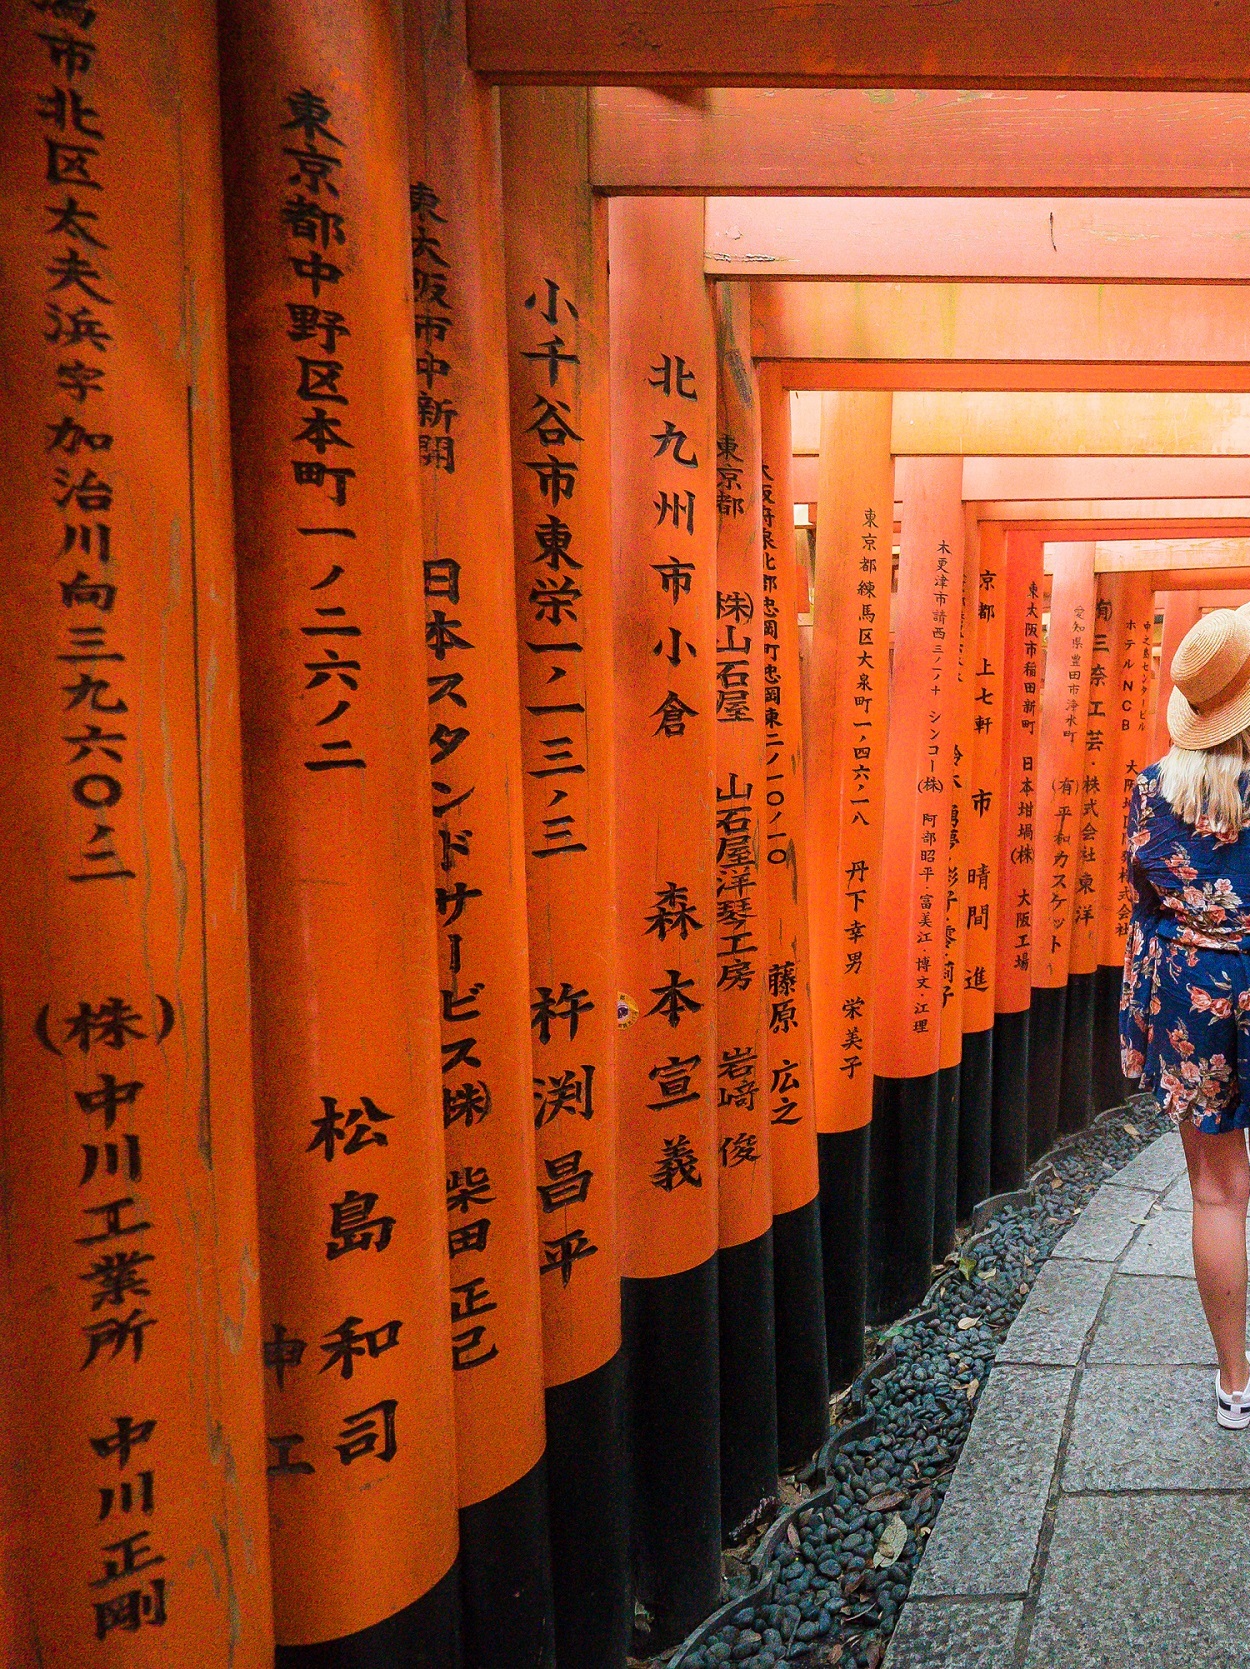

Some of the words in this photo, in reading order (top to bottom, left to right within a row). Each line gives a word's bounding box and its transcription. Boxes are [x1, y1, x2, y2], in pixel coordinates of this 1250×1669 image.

[716, 434, 745, 519] 東京都
[647, 353, 700, 738] 北九州市小倉
[977, 568, 997, 624] 京都
[716, 591, 754, 722] 株)山石屋
[974, 658, 996, 735] 上七軒
[1021, 580, 1039, 735] 東大阪市稲田新町
[716, 773, 758, 991] 山石屋洋琴工房
[843, 861, 870, 975] 丹下幸男
[1014, 889, 1031, 972] 大阪工場
[643, 882, 705, 1193] 森本宣義
[768, 961, 799, 1034] 藤原
[839, 996, 866, 1080] 栄美子
[769, 1059, 803, 1125] 広之
[89, 1416, 169, 1641] 中川正剛
